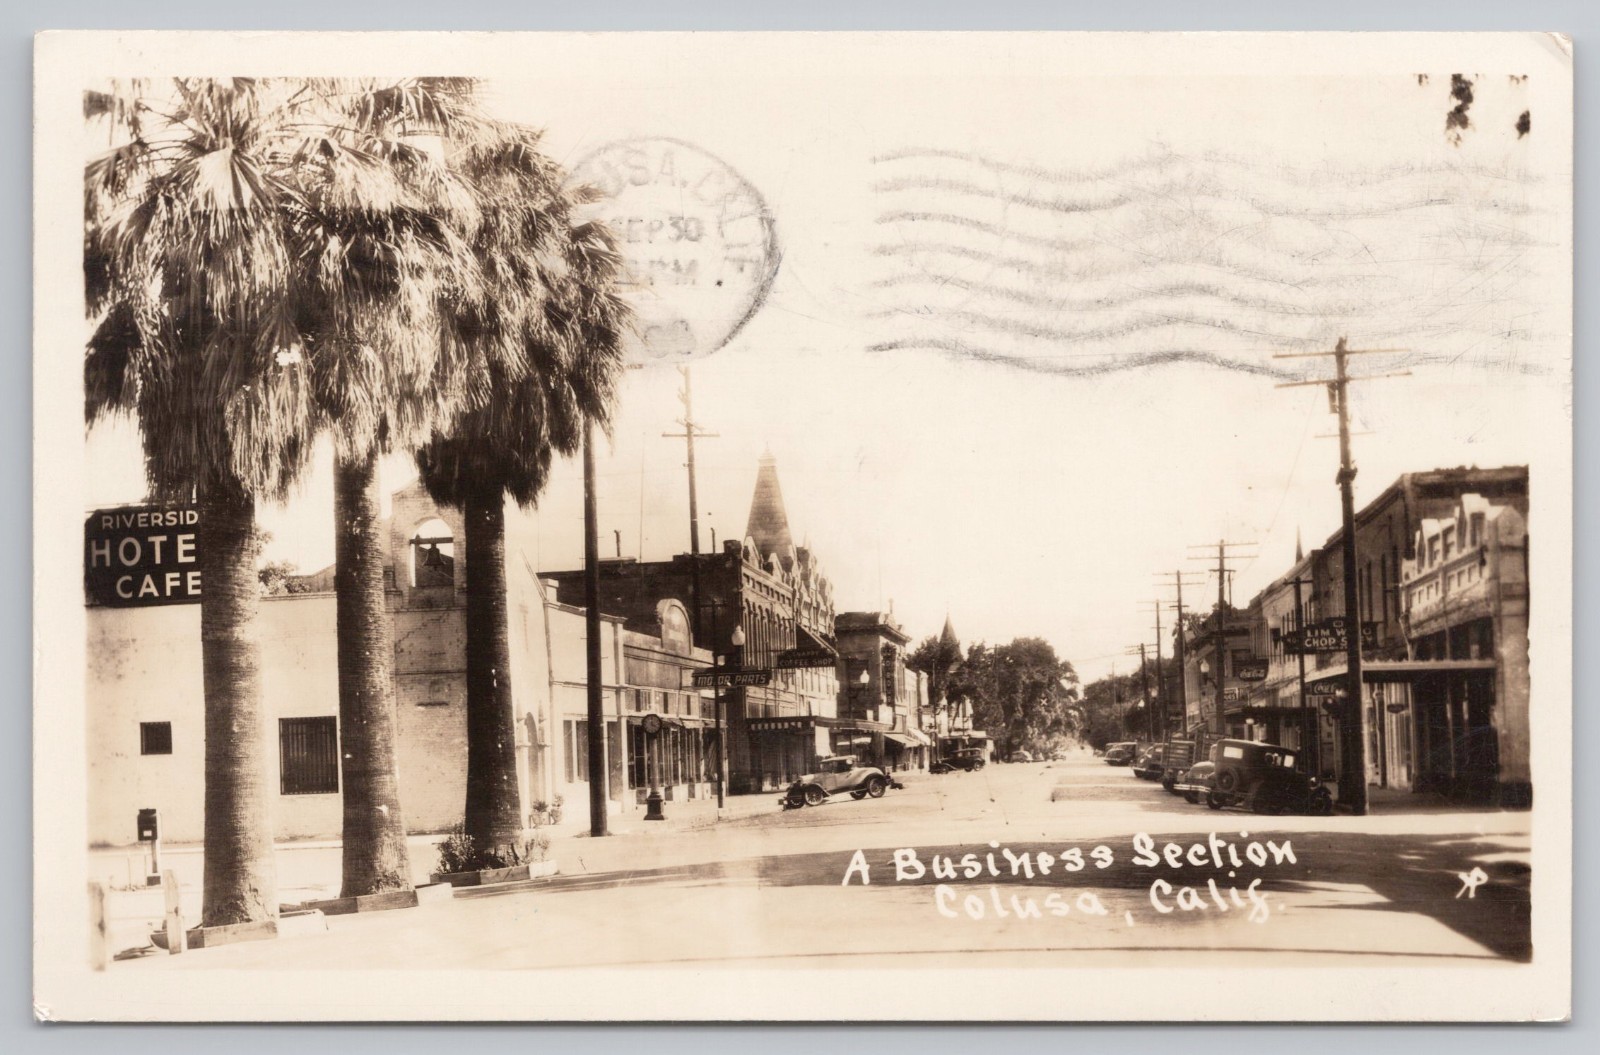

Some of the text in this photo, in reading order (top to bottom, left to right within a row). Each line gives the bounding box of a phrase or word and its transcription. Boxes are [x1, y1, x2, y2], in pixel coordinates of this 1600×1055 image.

[101, 510, 199, 529] RIVERSID
[91, 533, 197, 567] HOTE
[115, 571, 202, 599] CAFE
[1306, 629, 1331, 638] LIM
[1304, 637, 1336, 648] CHOP
[698, 673, 767, 686] MOOR PARTS
